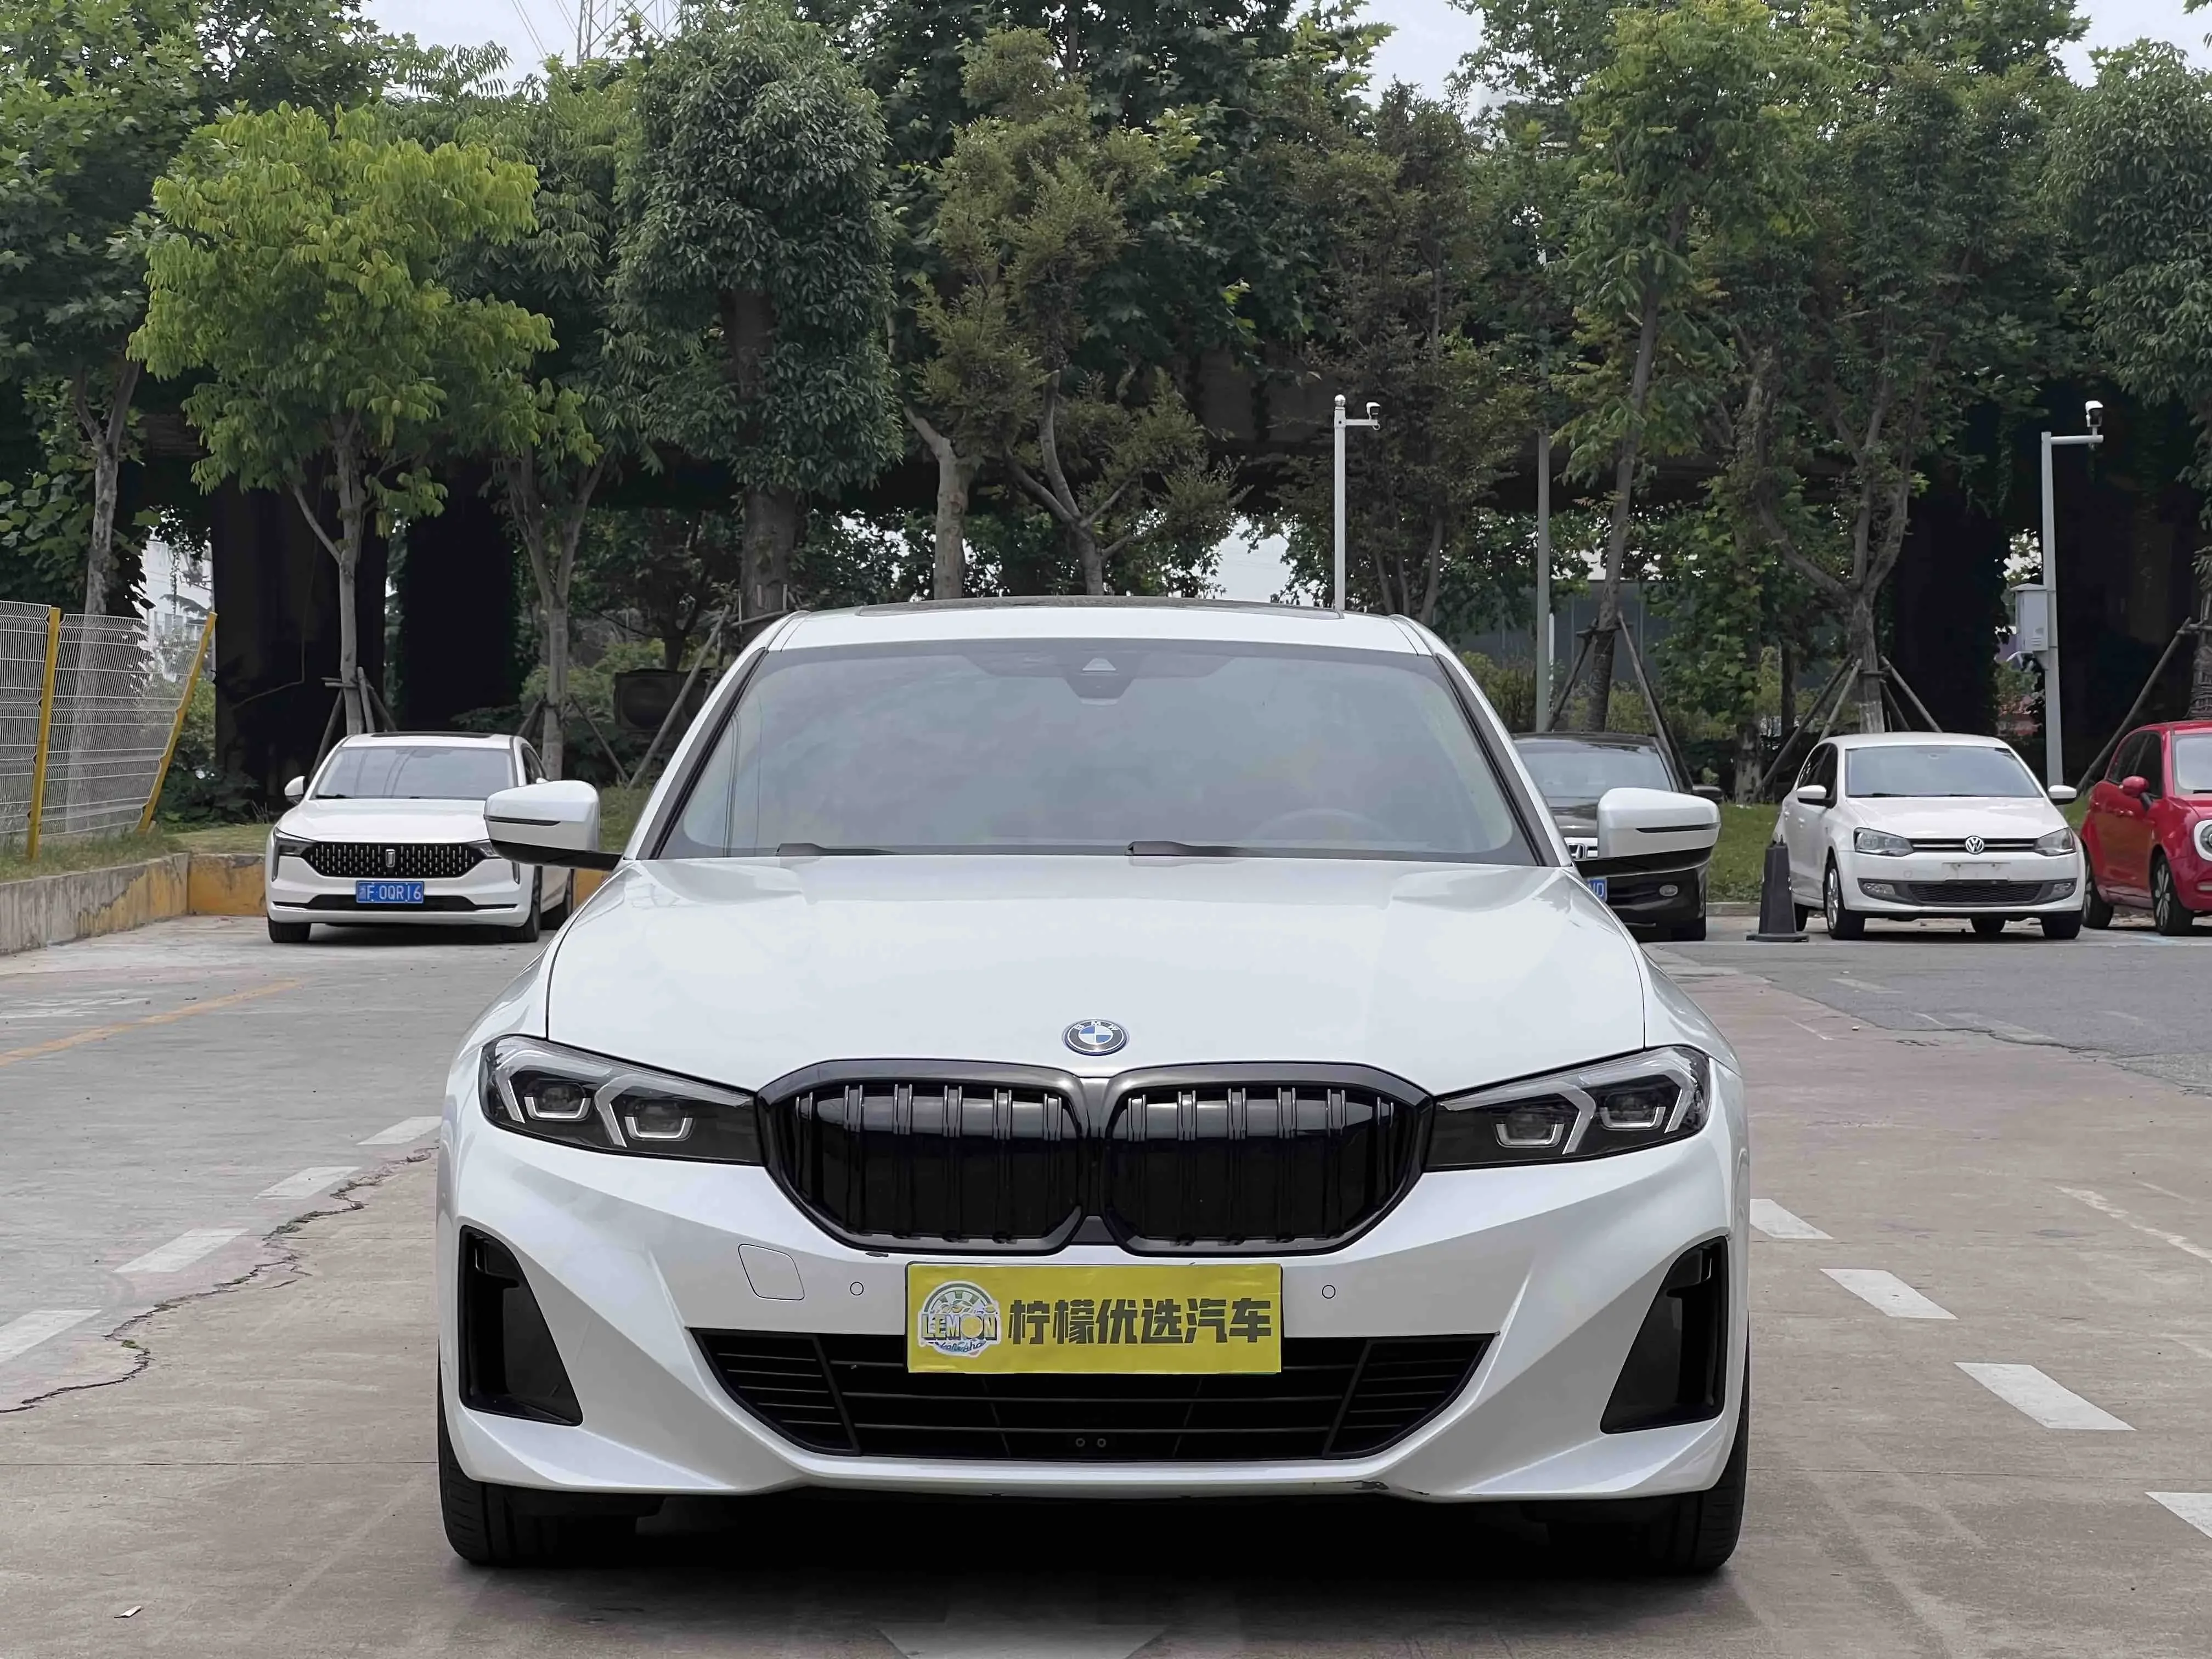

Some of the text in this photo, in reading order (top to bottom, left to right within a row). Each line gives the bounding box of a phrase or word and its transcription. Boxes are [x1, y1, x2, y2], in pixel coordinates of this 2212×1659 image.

[1074, 1020, 1119, 1031] BMW
[921, 1314, 997, 1341] LEMON
[1008, 1298, 1272, 1345] 柠檬优选汽车
